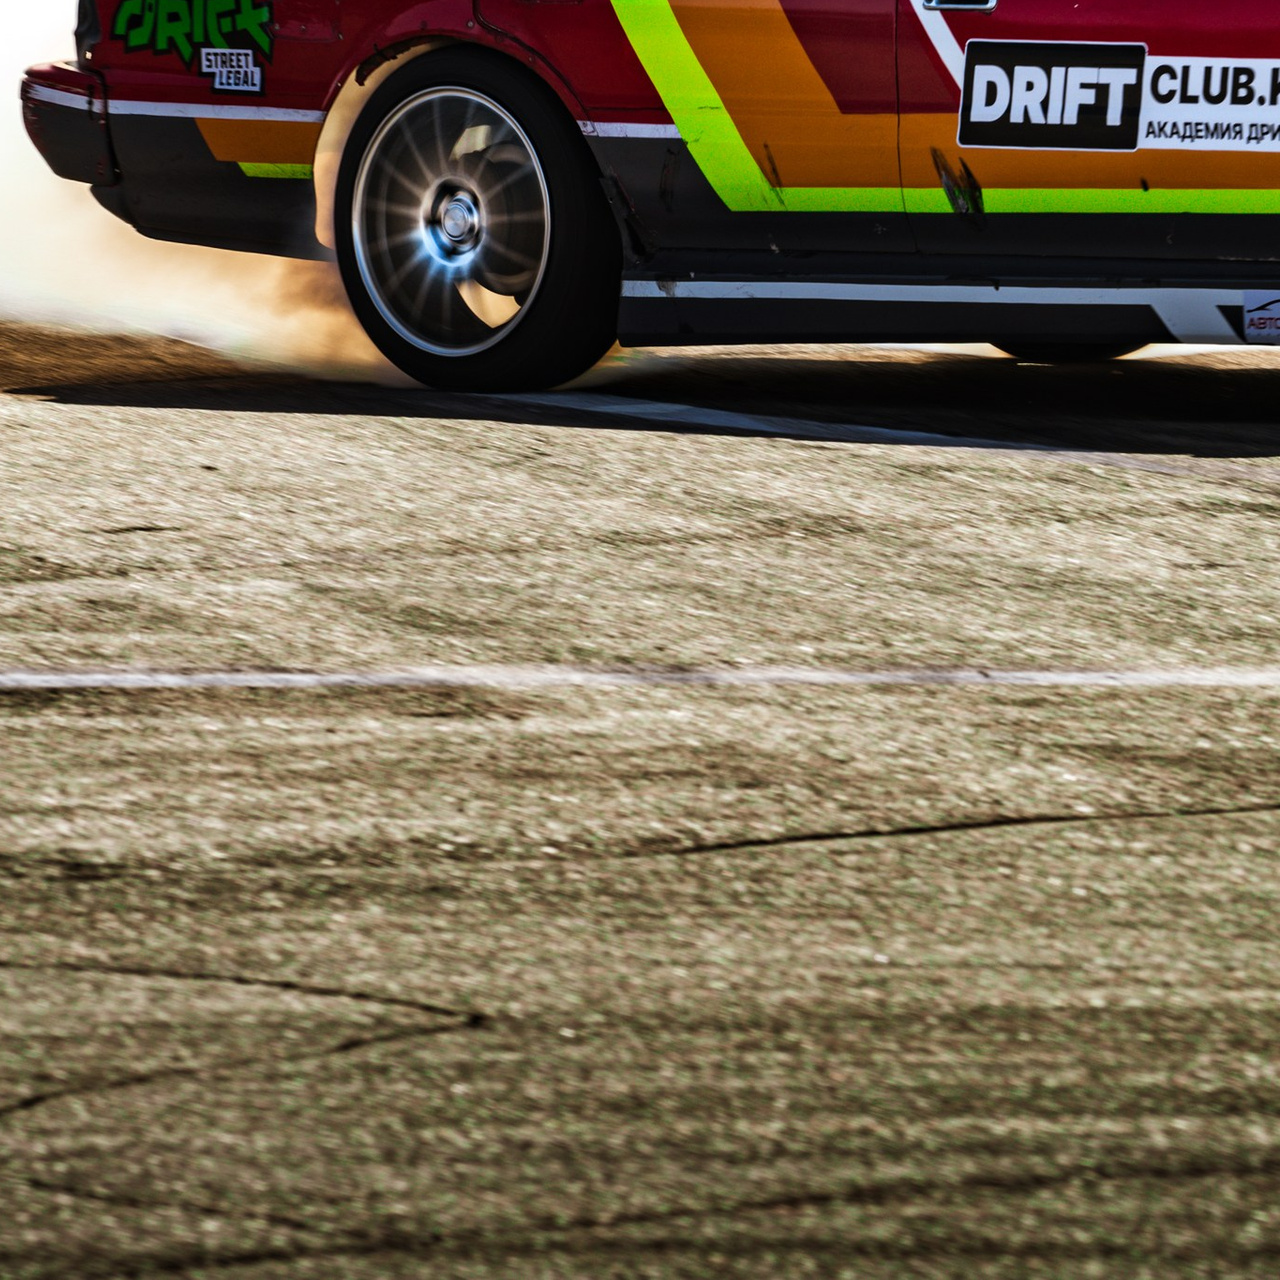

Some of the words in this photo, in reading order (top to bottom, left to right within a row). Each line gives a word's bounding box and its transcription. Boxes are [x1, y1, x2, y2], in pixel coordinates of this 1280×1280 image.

[205, 52, 251, 68] STREET
[218, 70, 258, 86] LEGAL
[970, 64, 1137, 126] DRIFT
[1145, 121, 1243, 142] АКАДЕМИЯ
